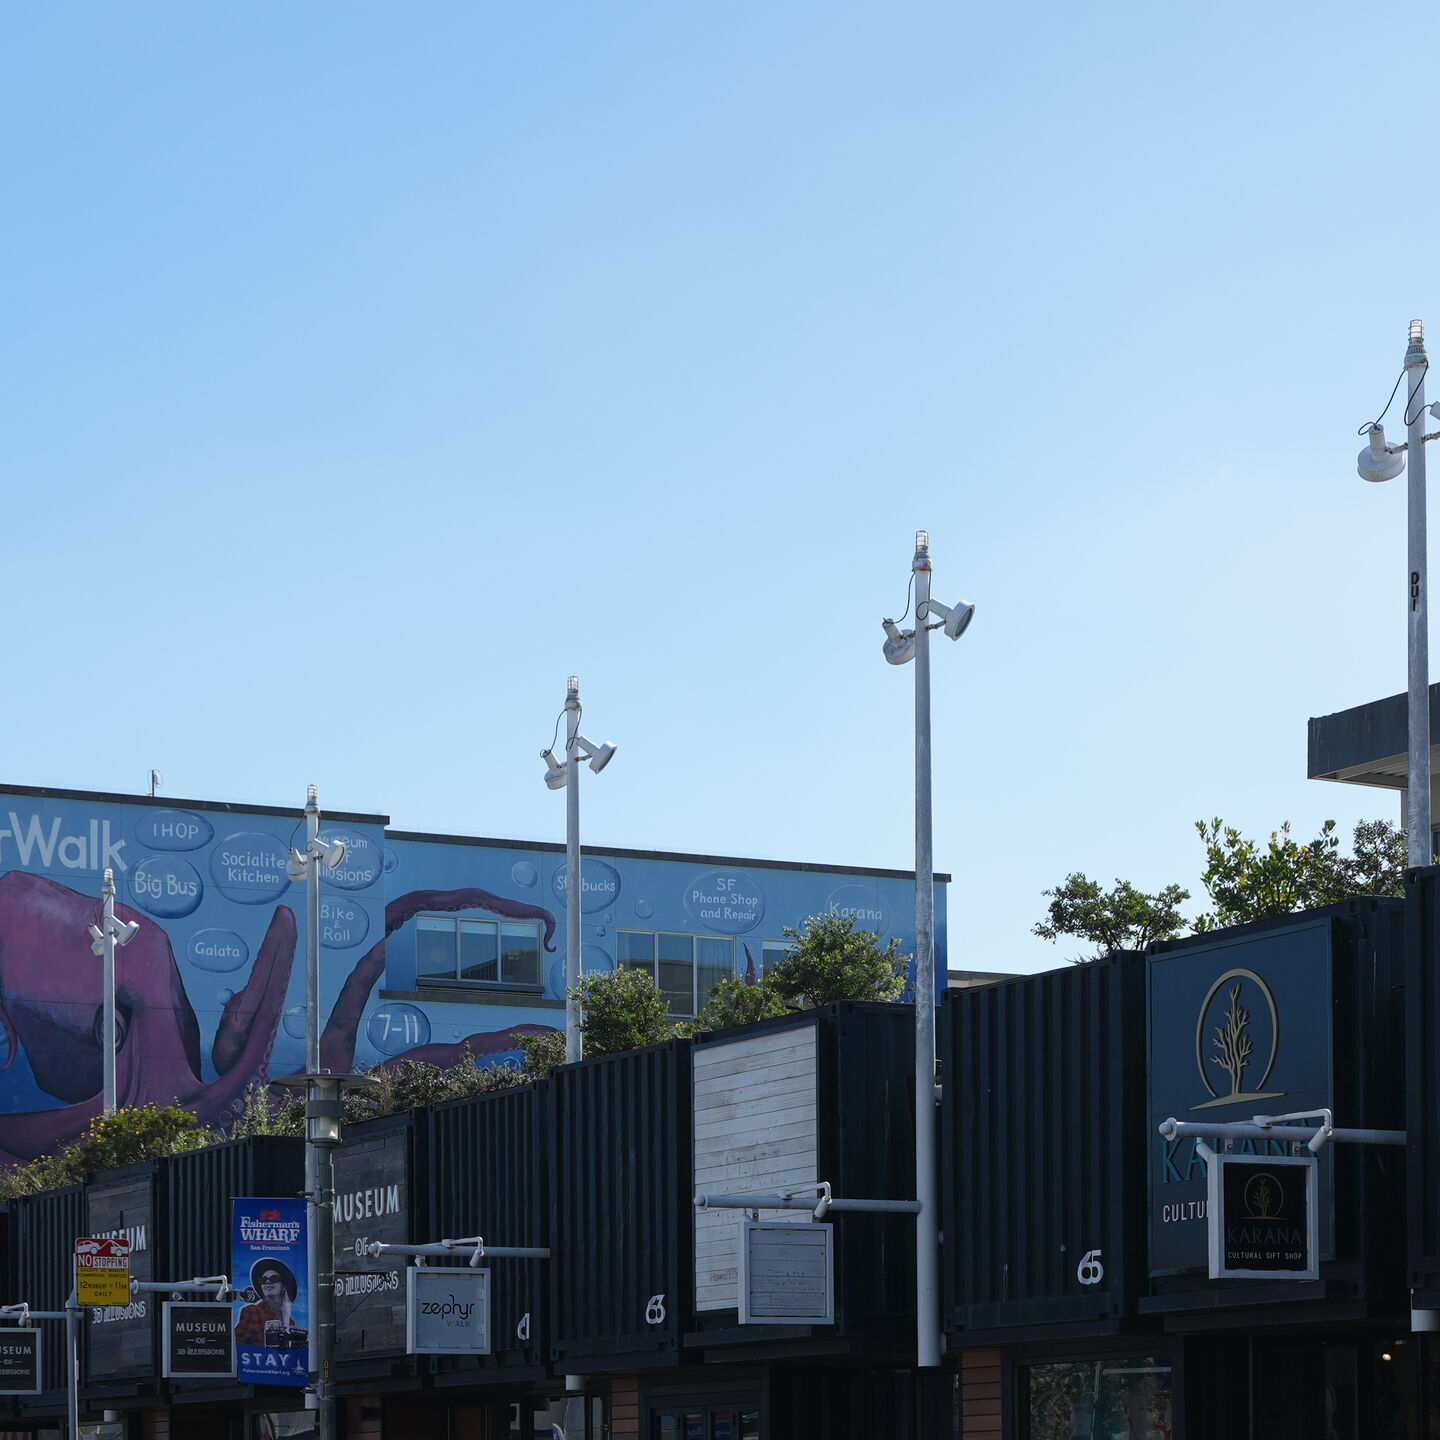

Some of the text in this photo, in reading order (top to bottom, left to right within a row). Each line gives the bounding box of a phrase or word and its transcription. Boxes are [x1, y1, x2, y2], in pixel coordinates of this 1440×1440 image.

[221, 851, 285, 870] Socialite
[228, 867, 279, 884] Kitchen
[135, 871, 198, 899] Big Bus
[556, 875, 616, 893] Stbucks
[716, 878, 736, 891] SF
[693, 891, 758, 908] Phone Shop
[320, 904, 354, 920] Bike
[701, 907, 757, 922] and Repair
[830, 900, 883, 921] Karana
[323, 926, 350, 941] Roll
[195, 942, 240, 957] Galata
[377, 1013, 419, 1044] 7-11
[333, 1185, 400, 1224] MUSEUM
[1163, 1200, 1209, 1223] CULTU
[240, 1228, 300, 1243] WHARF
[1228, 1226, 1303, 1245] KARANA
[78, 1254, 127, 1267] NO STOPPING
[1227, 1250, 1303, 1261] CULTURAL GIFT SHOP
[421, 1294, 475, 1320] zephyr
[176, 1322, 227, 1332] MUSEUM
[446, 1320, 471, 1328] WALK
[241, 1353, 289, 1366] STAY
